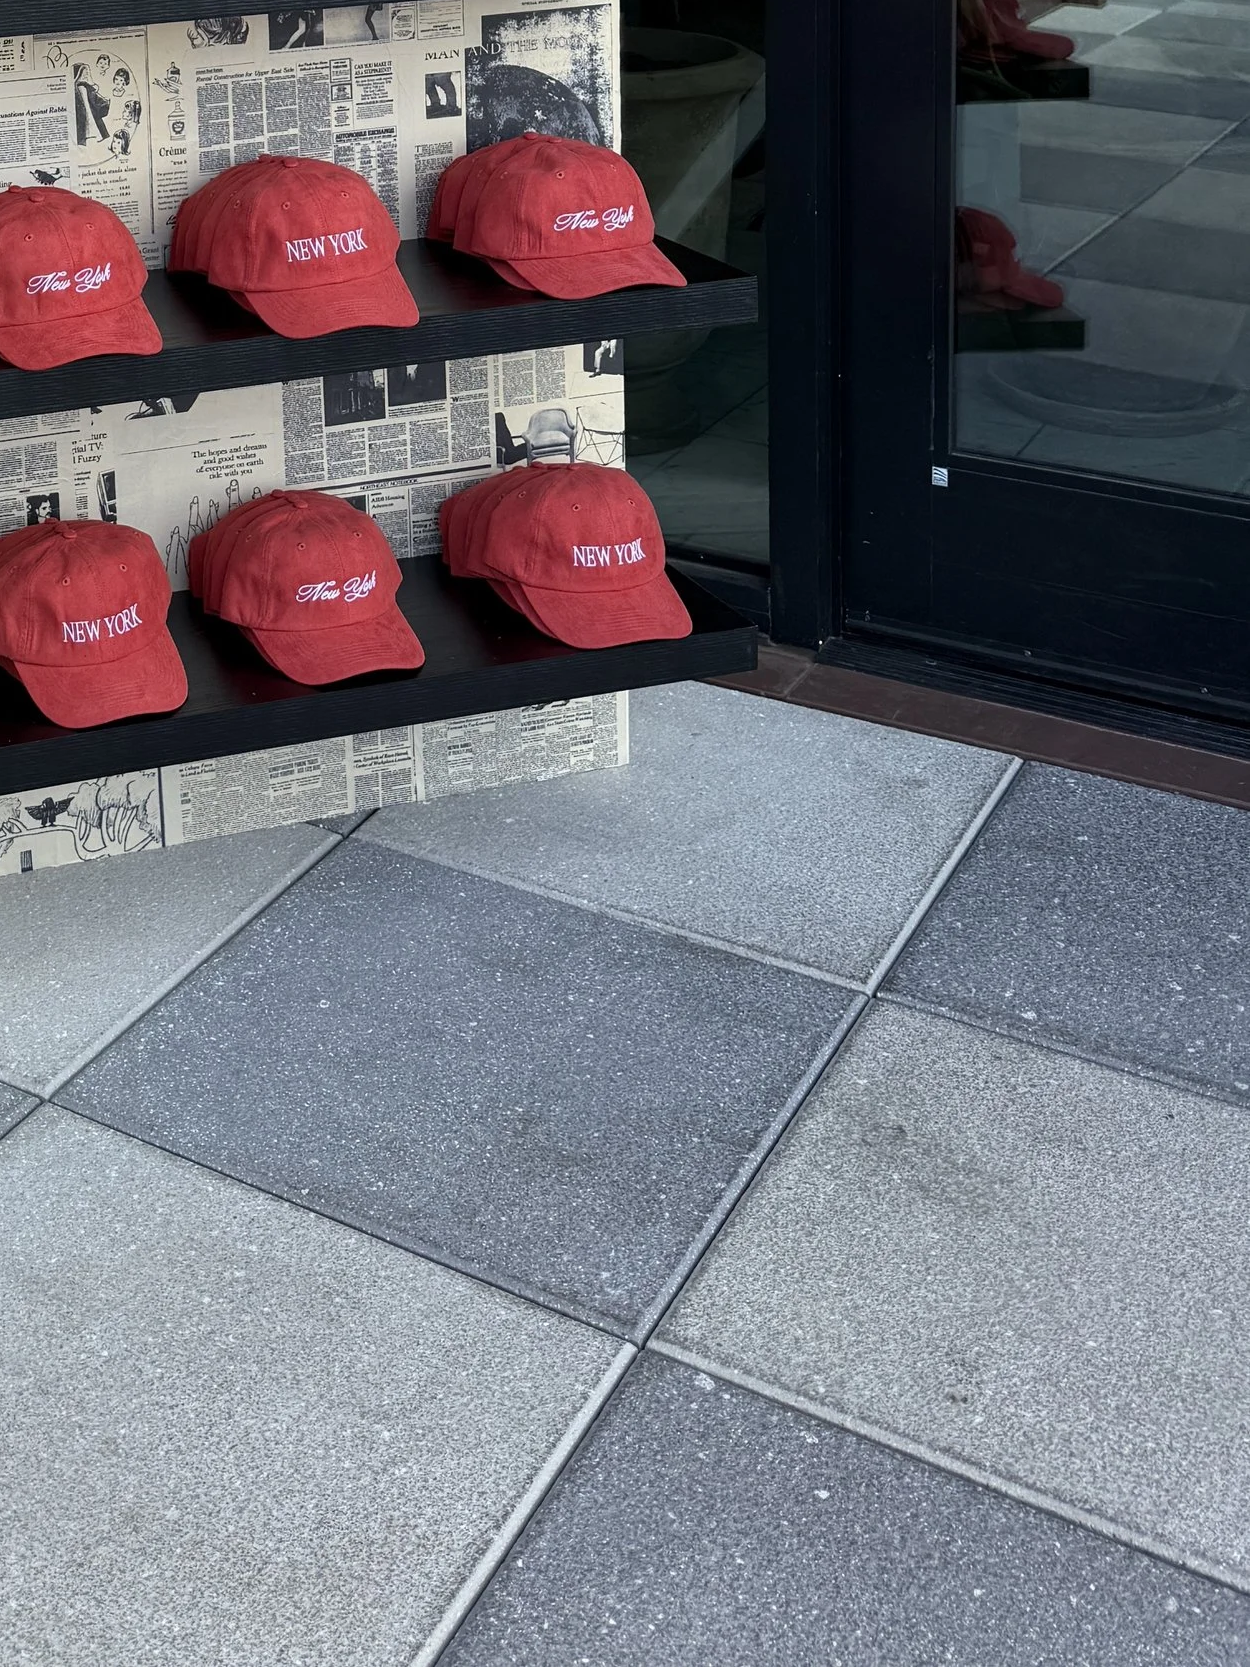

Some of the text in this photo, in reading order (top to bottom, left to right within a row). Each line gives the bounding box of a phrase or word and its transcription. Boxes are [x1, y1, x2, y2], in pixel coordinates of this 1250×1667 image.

[424, 49, 460, 61] MAN
[468, 43, 501, 57] AND
[214, 72, 245, 81] Construction
[254, 70, 270, 79] Upper
[25, 107, 49, 118] Against
[49, 106, 68, 114] Rabbi
[553, 204, 634, 232] New York
[285, 227, 368, 263] NEW YORK
[26, 261, 112, 295] New York
[77, 452, 102, 465] Fuzzy
[191, 443, 268, 459] The hopes and dreams
[203, 457, 216, 465] and
[217, 454, 235, 465] good
[205, 462, 235, 473] everyone
[246, 458, 264, 467] earth
[223, 468, 253, 478] with you
[572, 537, 646, 568] NEW YORK
[295, 570, 377, 603] New York
[62, 603, 143, 645] NEW YORK
